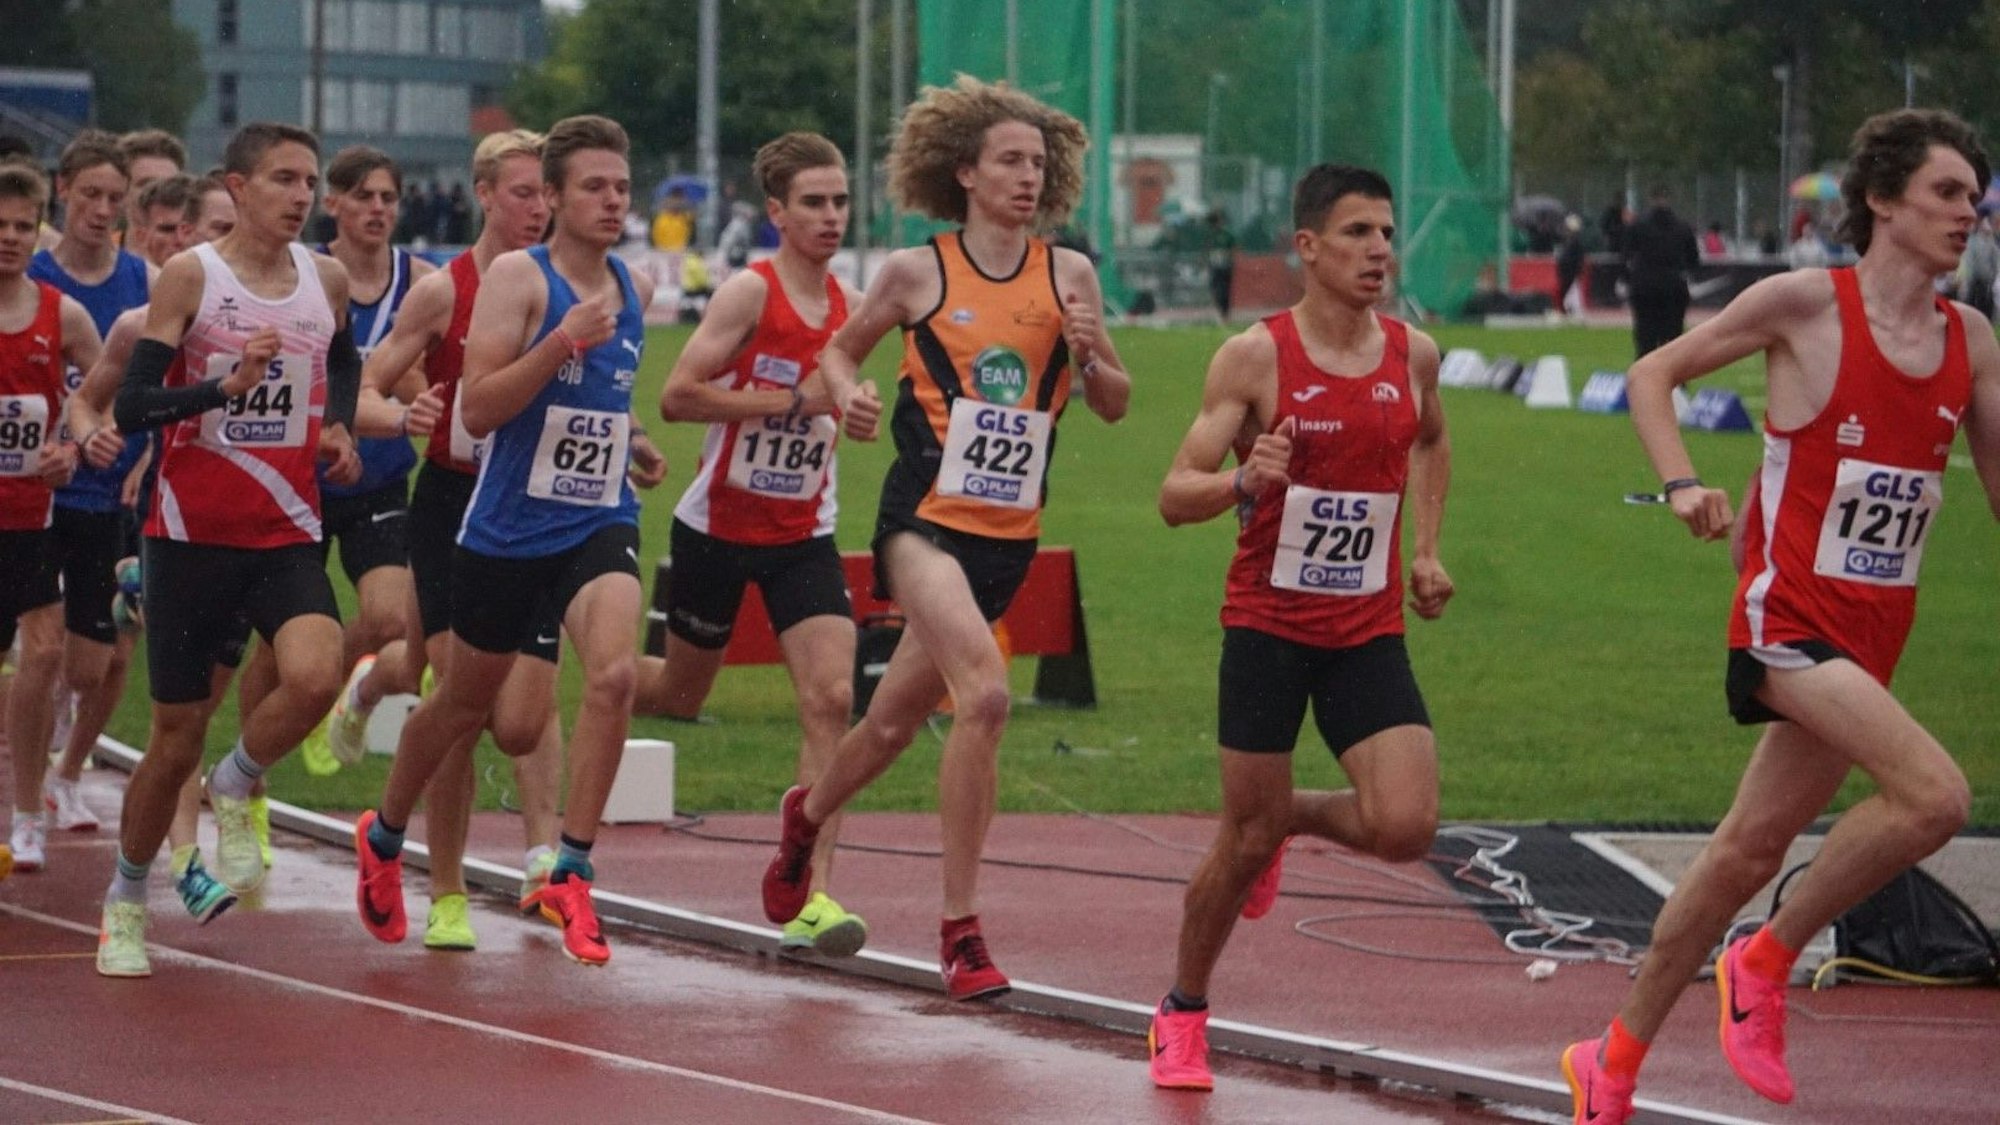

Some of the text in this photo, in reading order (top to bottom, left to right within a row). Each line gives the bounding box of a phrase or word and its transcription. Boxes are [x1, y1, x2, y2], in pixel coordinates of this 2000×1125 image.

[980, 365, 1022, 386] EAM
[251, 424, 284, 435] PLAN
[567, 414, 613, 438] GLS
[763, 413, 813, 436] GLS
[975, 408, 1028, 436] GLS
[553, 438, 613, 476] 621
[744, 431, 826, 471] 1184
[963, 435, 1033, 476] 422
[988, 480, 1019, 495] PLAN
[1865, 471, 1924, 503] GLS
[1311, 497, 1369, 522] GLS
[1838, 498, 1931, 548] 1211
[1303, 522, 1374, 563] 720
[1327, 569, 1361, 582] PLAN
